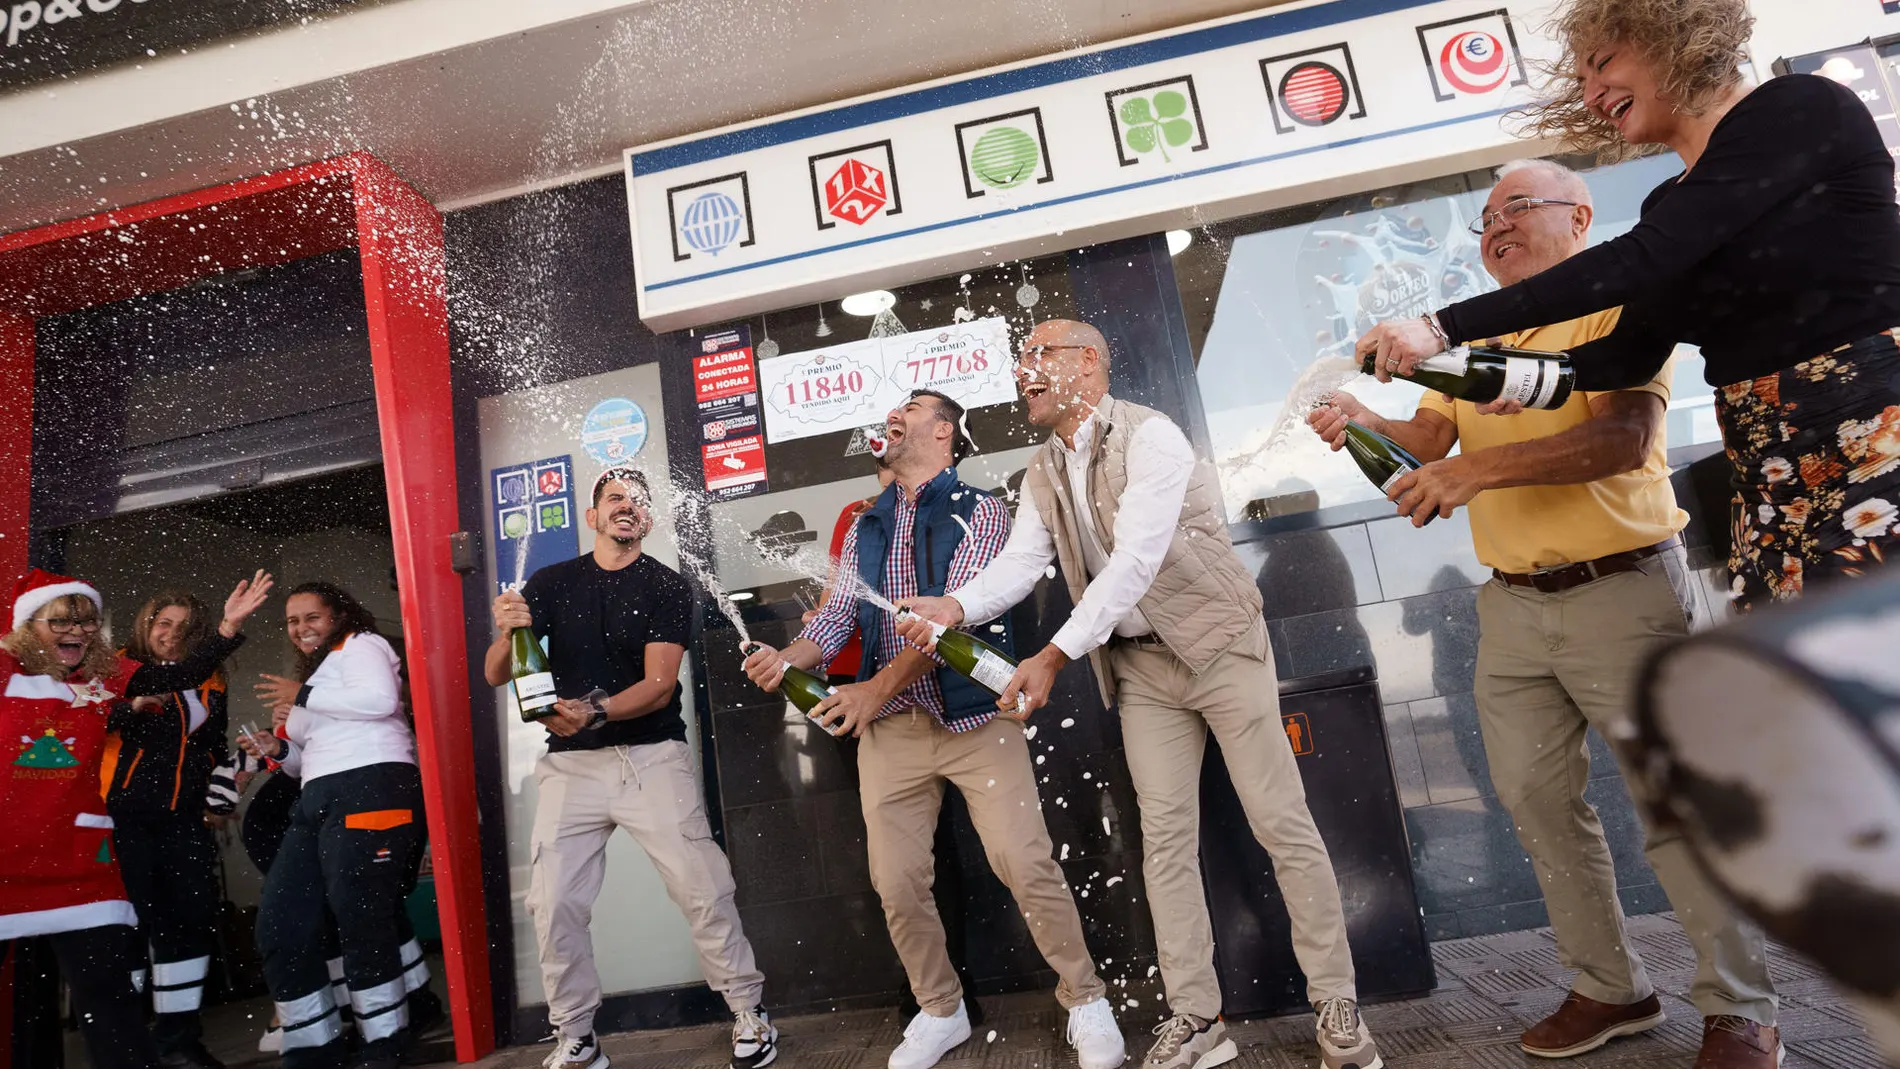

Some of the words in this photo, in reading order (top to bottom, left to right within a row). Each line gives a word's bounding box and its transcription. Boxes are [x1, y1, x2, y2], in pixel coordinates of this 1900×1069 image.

[1373, 269, 1430, 312] SORTEO
[930, 341, 966, 354] PREMIO
[699, 351, 746, 368] ALARMA
[907, 348, 988, 384] 77768
[698, 364, 750, 380] CONECTADA
[807, 363, 842, 375] PREMIO
[701, 383, 714, 392] 24
[716, 376, 750, 390] HORAS
[786, 370, 863, 405] 11840
[925, 377, 956, 387] VENDIDO
[801, 399, 832, 409] VENDIDO
[707, 443, 726, 452] ZONA
[726, 437, 758, 448] VIGILADA
[12, 769, 77, 779] NAVIDAD
